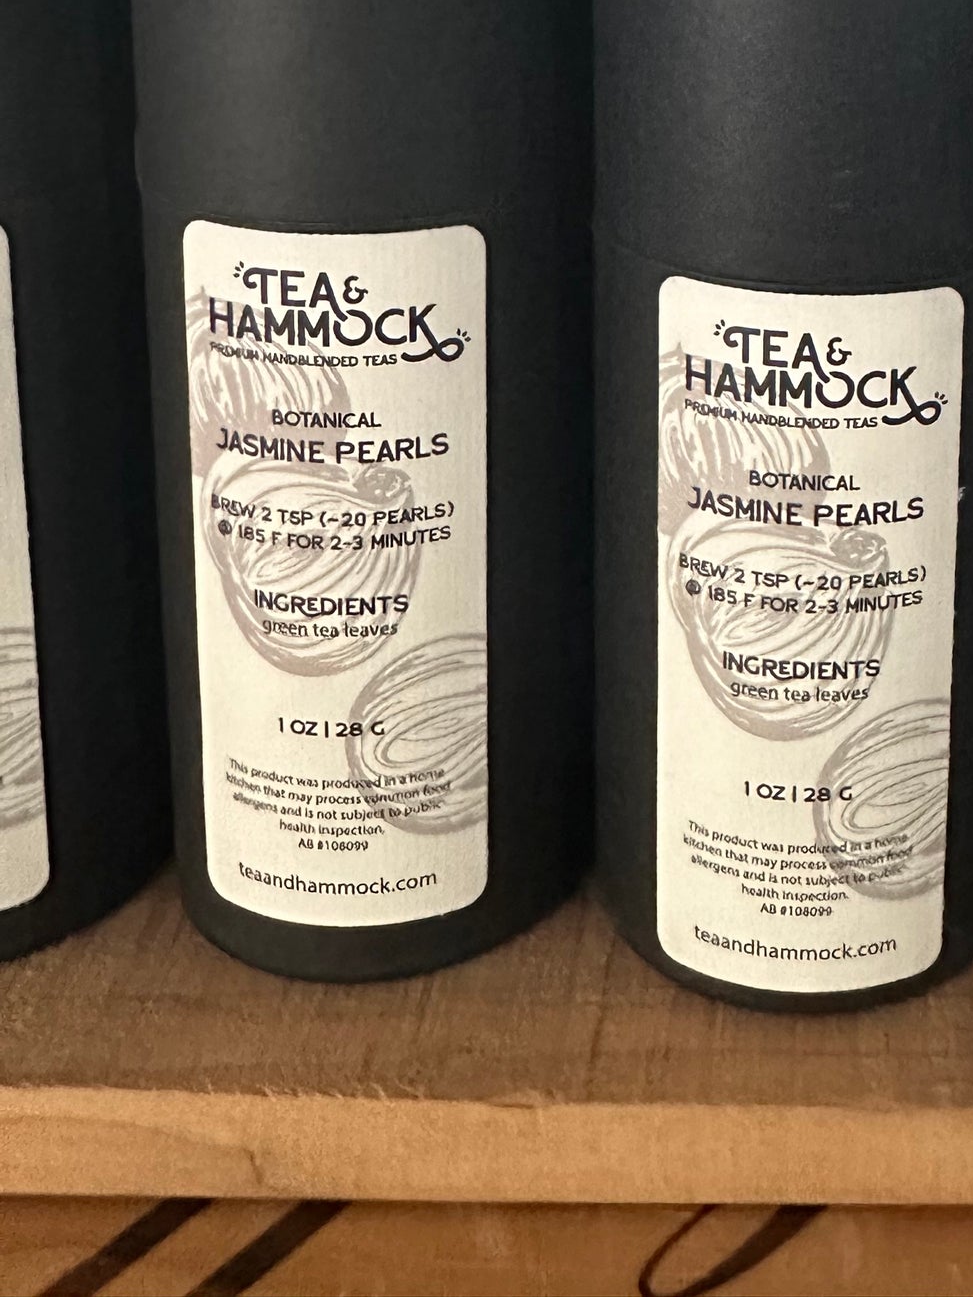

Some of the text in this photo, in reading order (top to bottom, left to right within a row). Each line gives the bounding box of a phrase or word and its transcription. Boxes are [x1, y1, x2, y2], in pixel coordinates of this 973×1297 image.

[242, 267, 368, 321] TEA &
[209, 297, 465, 363] HAMMOCK
[262, 350, 359, 367] HANDBLENDED
[362, 353, 398, 366] TEAS
[723, 325, 852, 383] TEA &
[685, 353, 942, 426] HAMMOCK
[271, 409, 382, 429] BOTANICAL
[684, 398, 878, 429] PREMIUM HANDBLENDED TEAS
[216, 427, 450, 464] JASMINE PEARLS
[749, 469, 861, 491] BOTANICAL
[211, 493, 256, 518] BREW
[261, 506, 273, 522] 2
[277, 508, 313, 526] TSP
[373, 500, 455, 526] PEARLS)
[687, 486, 924, 527] JASMINE PEARLS
[238, 524, 265, 543] 185
[272, 531, 283, 546] F
[287, 532, 324, 550] FOR
[371, 525, 452, 550] MINUTES
[678, 552, 728, 580] BREW
[733, 568, 746, 584] 2
[751, 570, 789, 588] TSP
[849, 565, 927, 589] PEARLS)
[253, 589, 410, 618] INGREDIENTS
[707, 585, 737, 605] 185
[744, 593, 756, 607] F
[760, 595, 799, 613] FOR
[804, 598, 839, 614] 2-3
[845, 590, 923, 614] MINUTES
[262, 619, 398, 638] green tea leaves
[722, 650, 881, 681] INGREDIENTS
[730, 681, 869, 702] green tea leaves
[278, 717, 386, 737] 1 OZ 28 G
[744, 781, 852, 801] 1 OZ 28 G
[689, 820, 709, 837] This
[712, 830, 758, 849] product
[761, 842, 784, 852] was
[725, 849, 748, 863] that
[752, 856, 777, 869] may
[780, 860, 827, 870] process
[238, 862, 437, 896] teaandhammock.com
[741, 883, 780, 900] health
[743, 871, 765, 882] and
[768, 873, 778, 883] is
[781, 875, 801, 885] not
[760, 902, 777, 914] AB
[694, 925, 896, 960] teaandhammock.com
